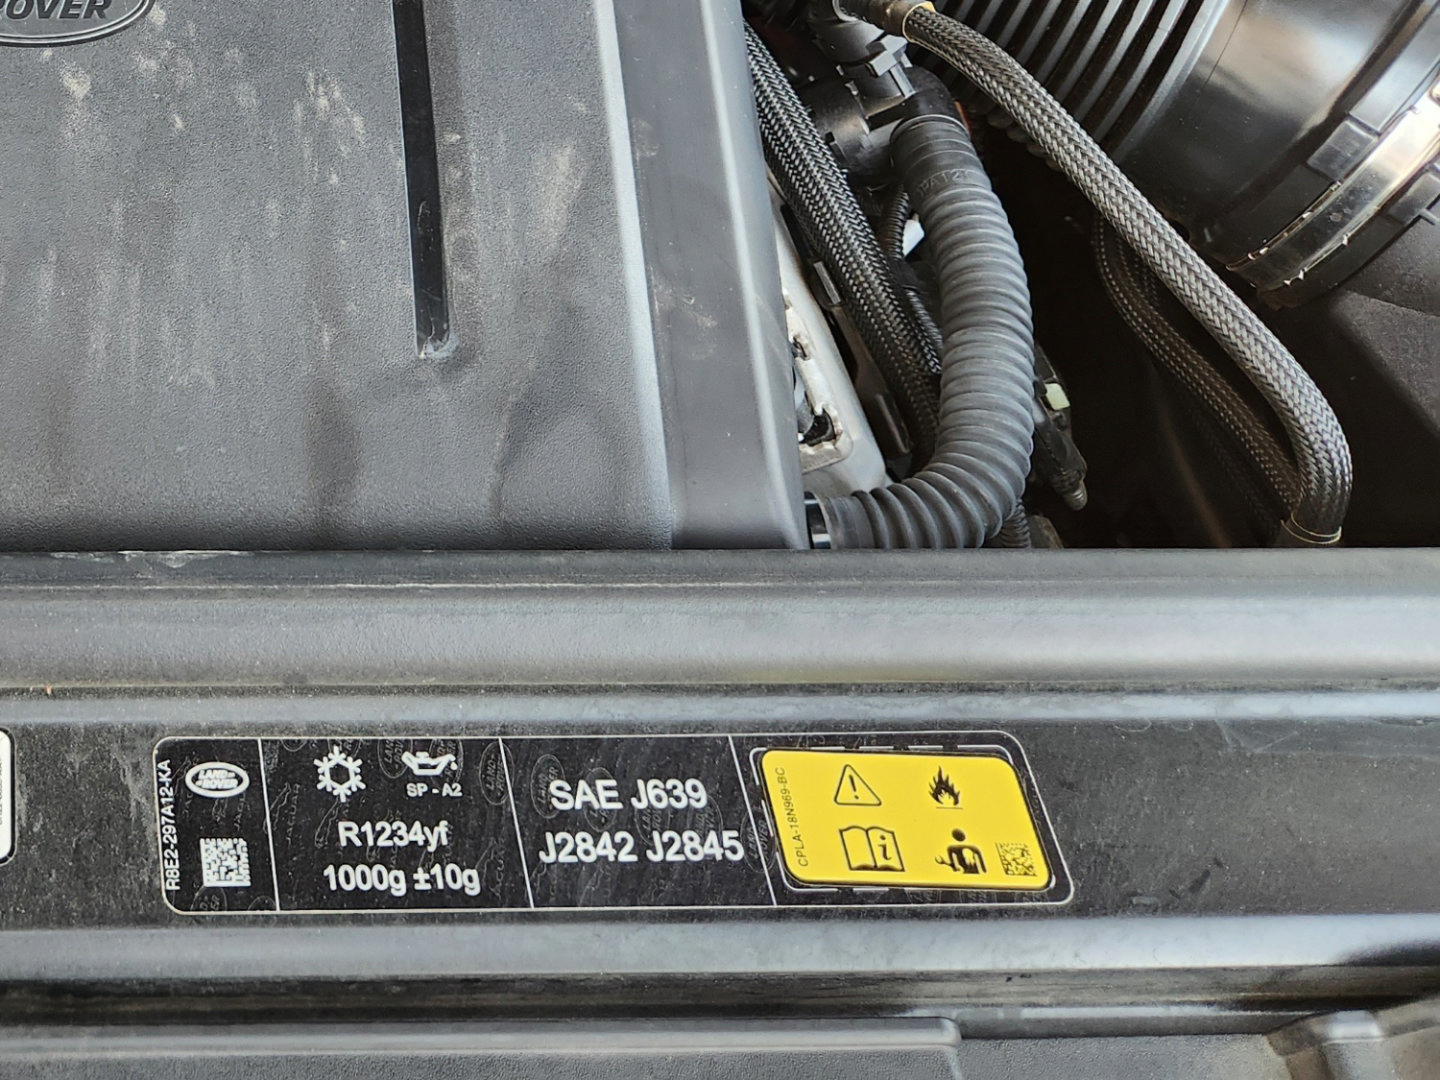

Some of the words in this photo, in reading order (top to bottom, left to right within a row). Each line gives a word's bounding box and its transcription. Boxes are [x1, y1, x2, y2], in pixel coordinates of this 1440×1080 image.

[406, 783, 428, 797] SP
[442, 783, 463, 797] A2
[549, 779, 623, 810] SAE
[630, 778, 708, 809] J639
[157, 759, 181, 891] R8E2-297A12-KA
[775, 767, 809, 867] CPLA-18N969-BC
[337, 820, 449, 852] R1234yf
[538, 831, 639, 863] J2842
[645, 830, 745, 862] J2845
[323, 863, 407, 897] 1000g
[412, 863, 482, 897] ±10g
